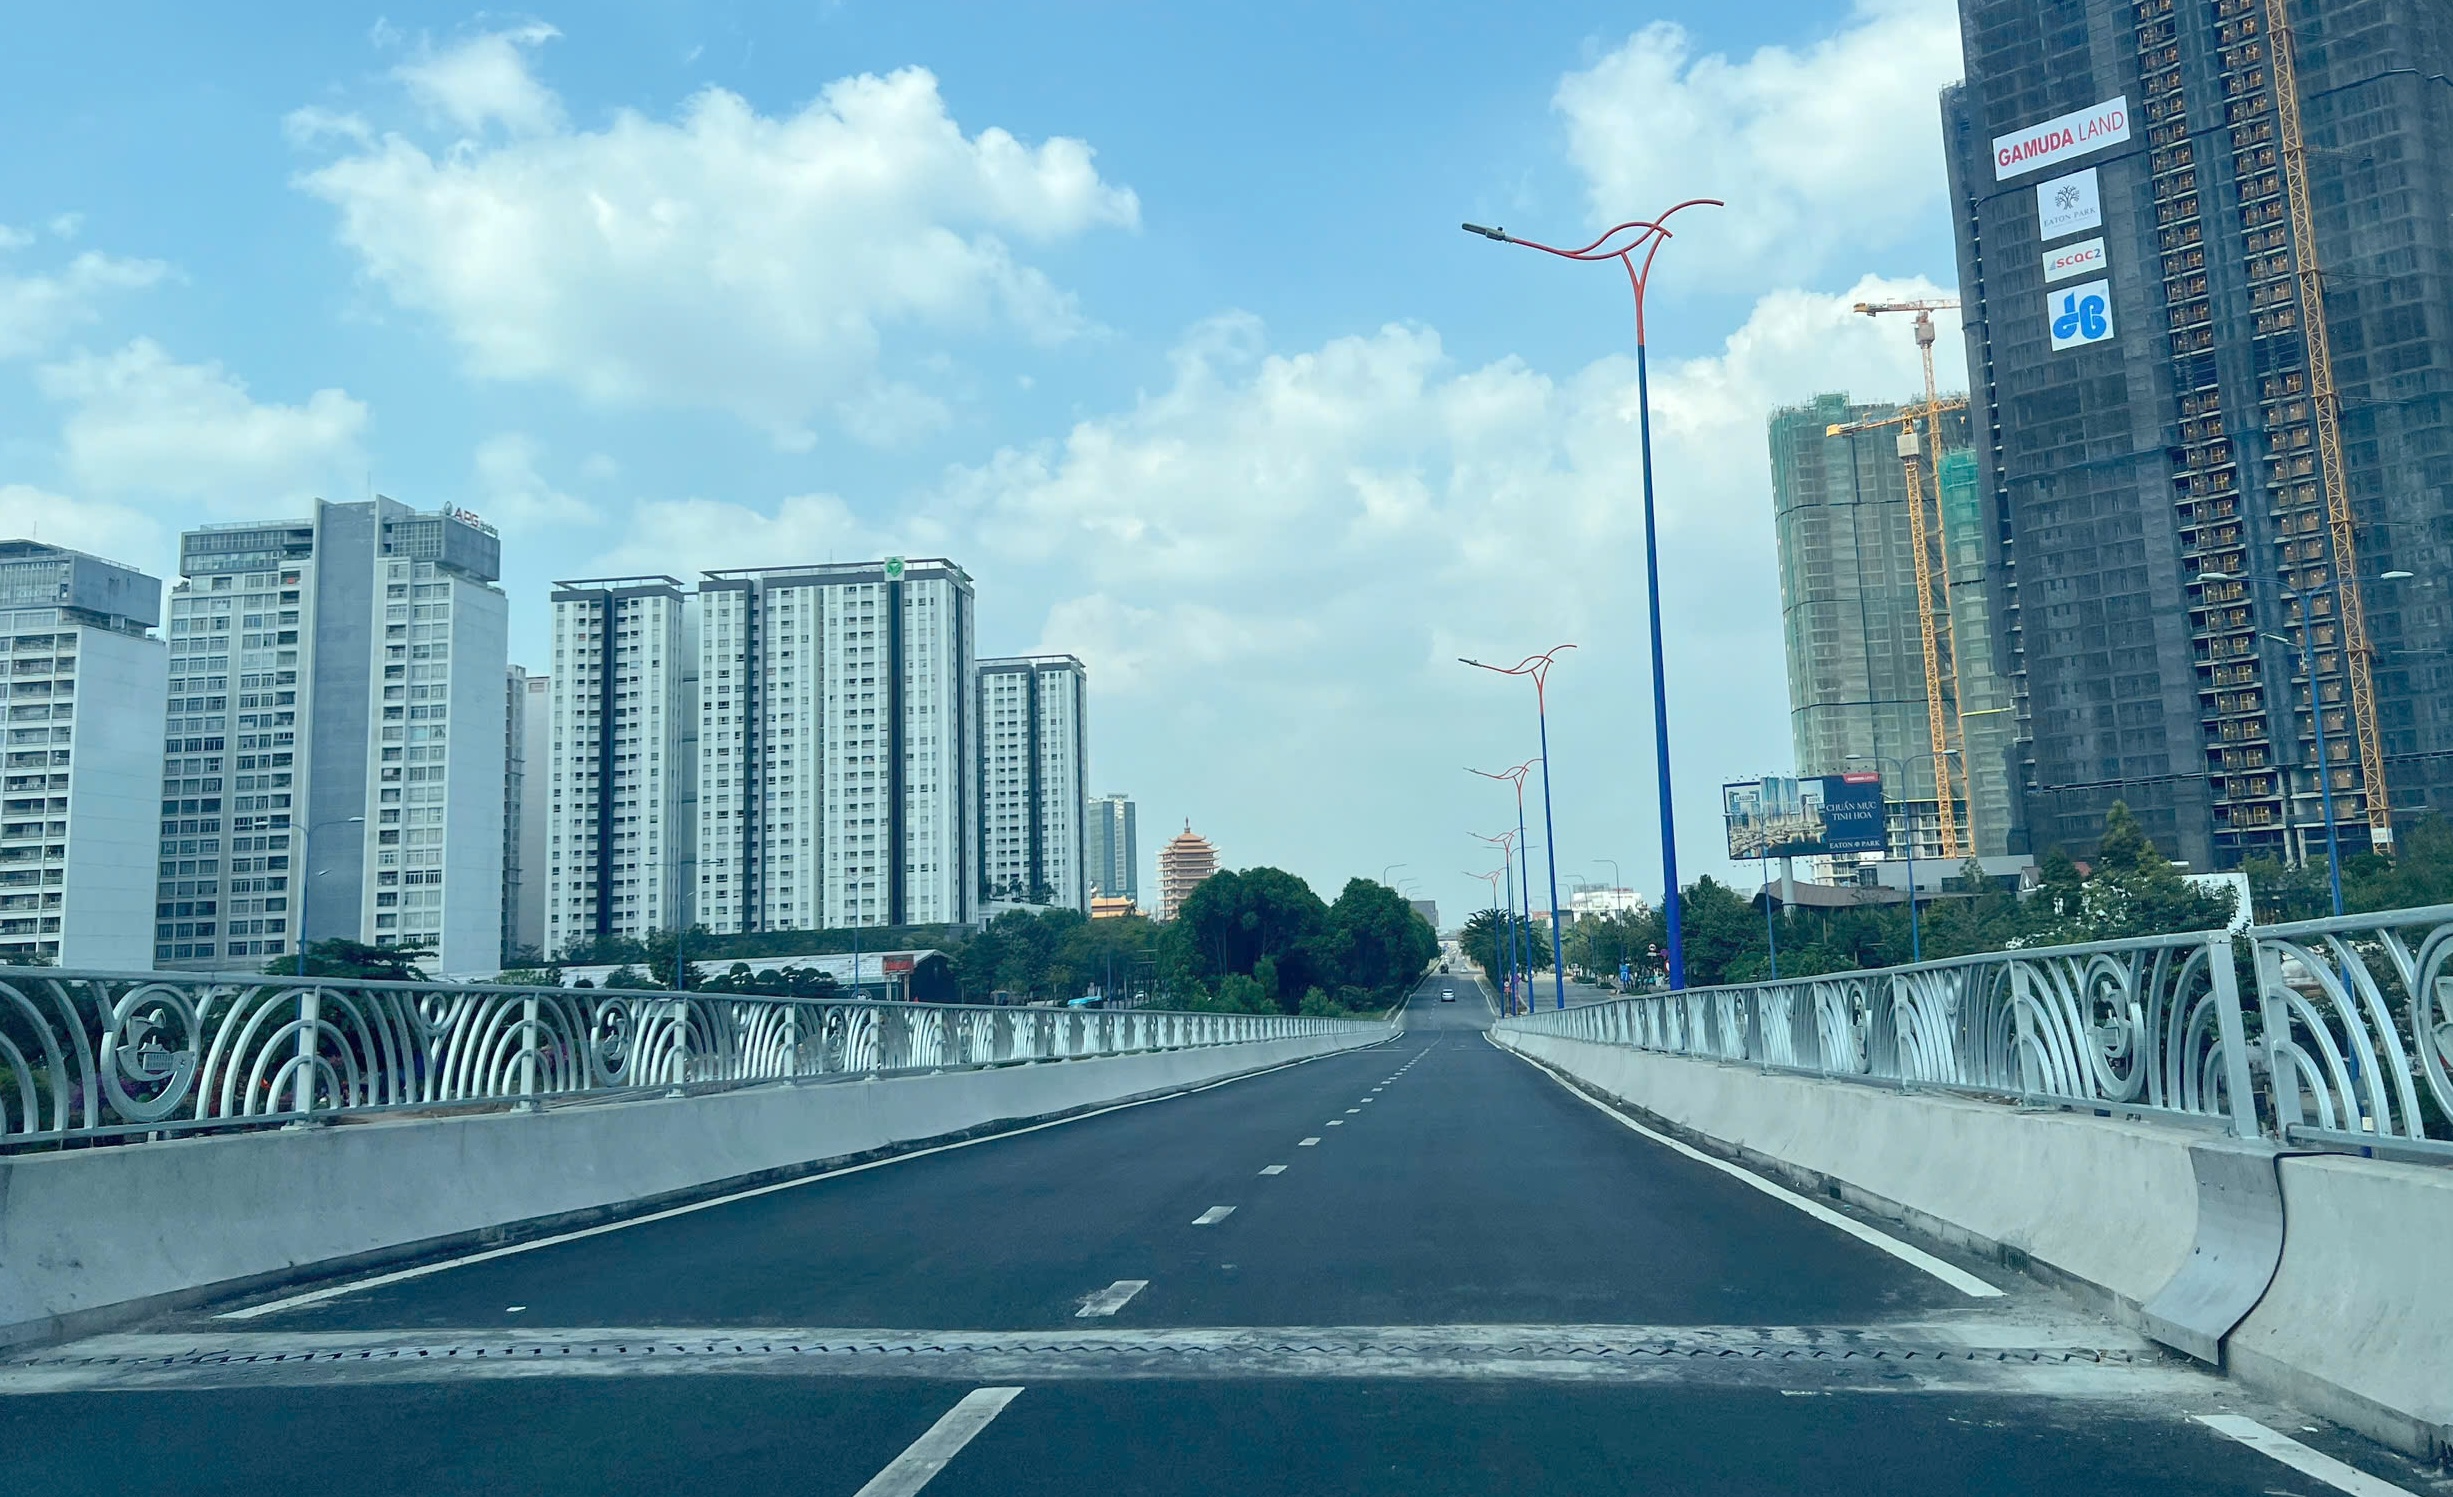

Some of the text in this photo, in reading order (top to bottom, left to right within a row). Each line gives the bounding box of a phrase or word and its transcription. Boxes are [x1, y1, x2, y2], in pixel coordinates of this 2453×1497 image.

[1998, 111, 2124, 167] GAMUDA LAND
[2044, 213, 2072, 228] EATON
[2074, 207, 2096, 219] PARK
[1832, 811, 1872, 821] TINH HOA
[1829, 839, 1880, 849] EATON PARK
